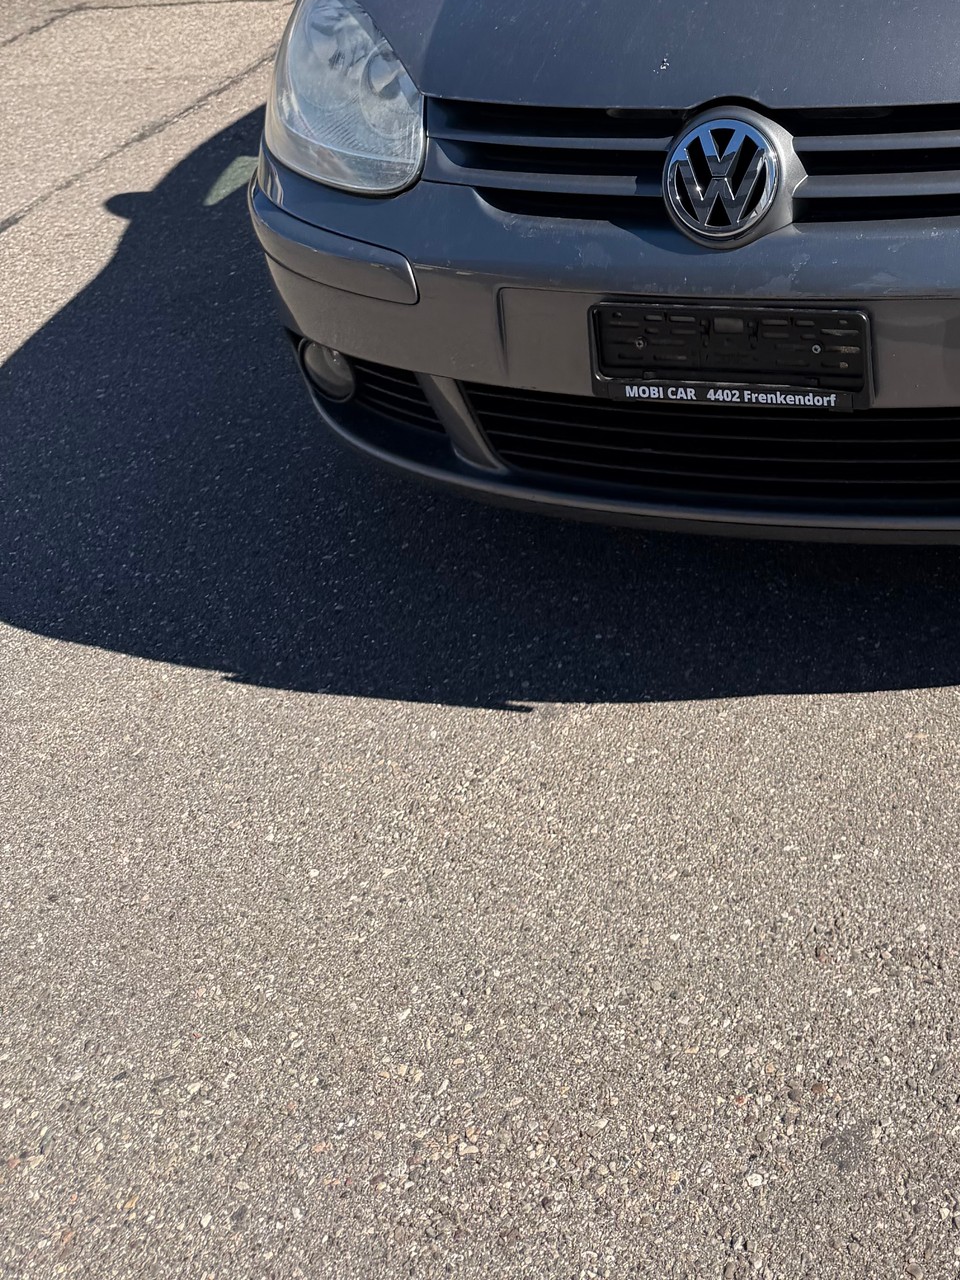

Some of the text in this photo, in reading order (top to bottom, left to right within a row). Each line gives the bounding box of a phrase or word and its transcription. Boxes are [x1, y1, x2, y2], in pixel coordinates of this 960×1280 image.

[668, 120, 776, 235] VW
[624, 384, 837, 407] MOBI CAR 4402 Frenkendorf
